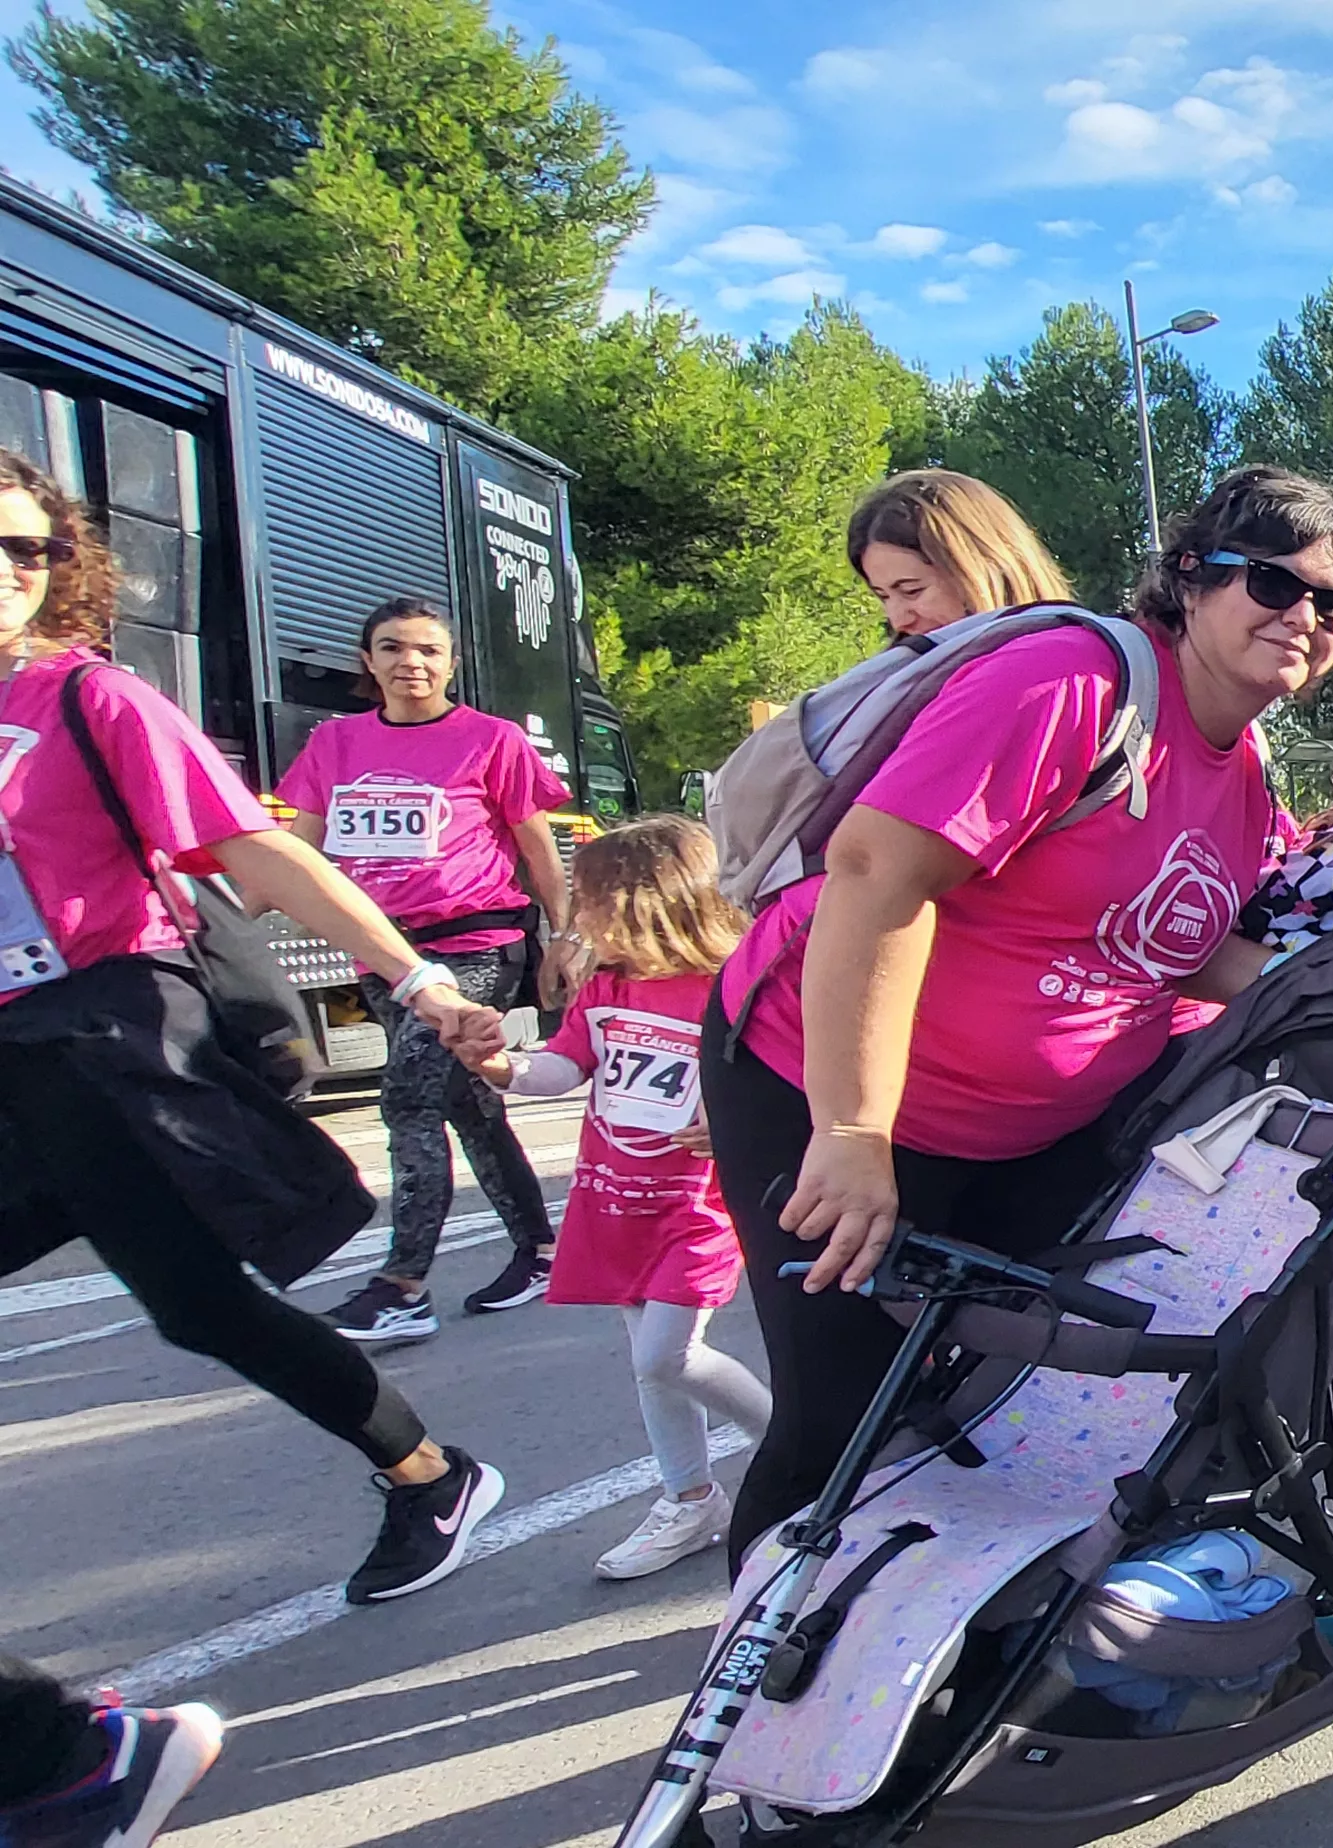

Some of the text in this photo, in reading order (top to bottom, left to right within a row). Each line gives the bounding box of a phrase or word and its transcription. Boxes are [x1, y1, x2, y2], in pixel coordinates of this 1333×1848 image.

[478, 478, 551, 536] SONIDO
[486, 525, 550, 565] CONNECTED
[338, 809, 426, 836] 3150
[640, 1034, 699, 1058] CÁNCER
[604, 1048, 690, 1099] 574
[719, 1640, 753, 1681] MID
